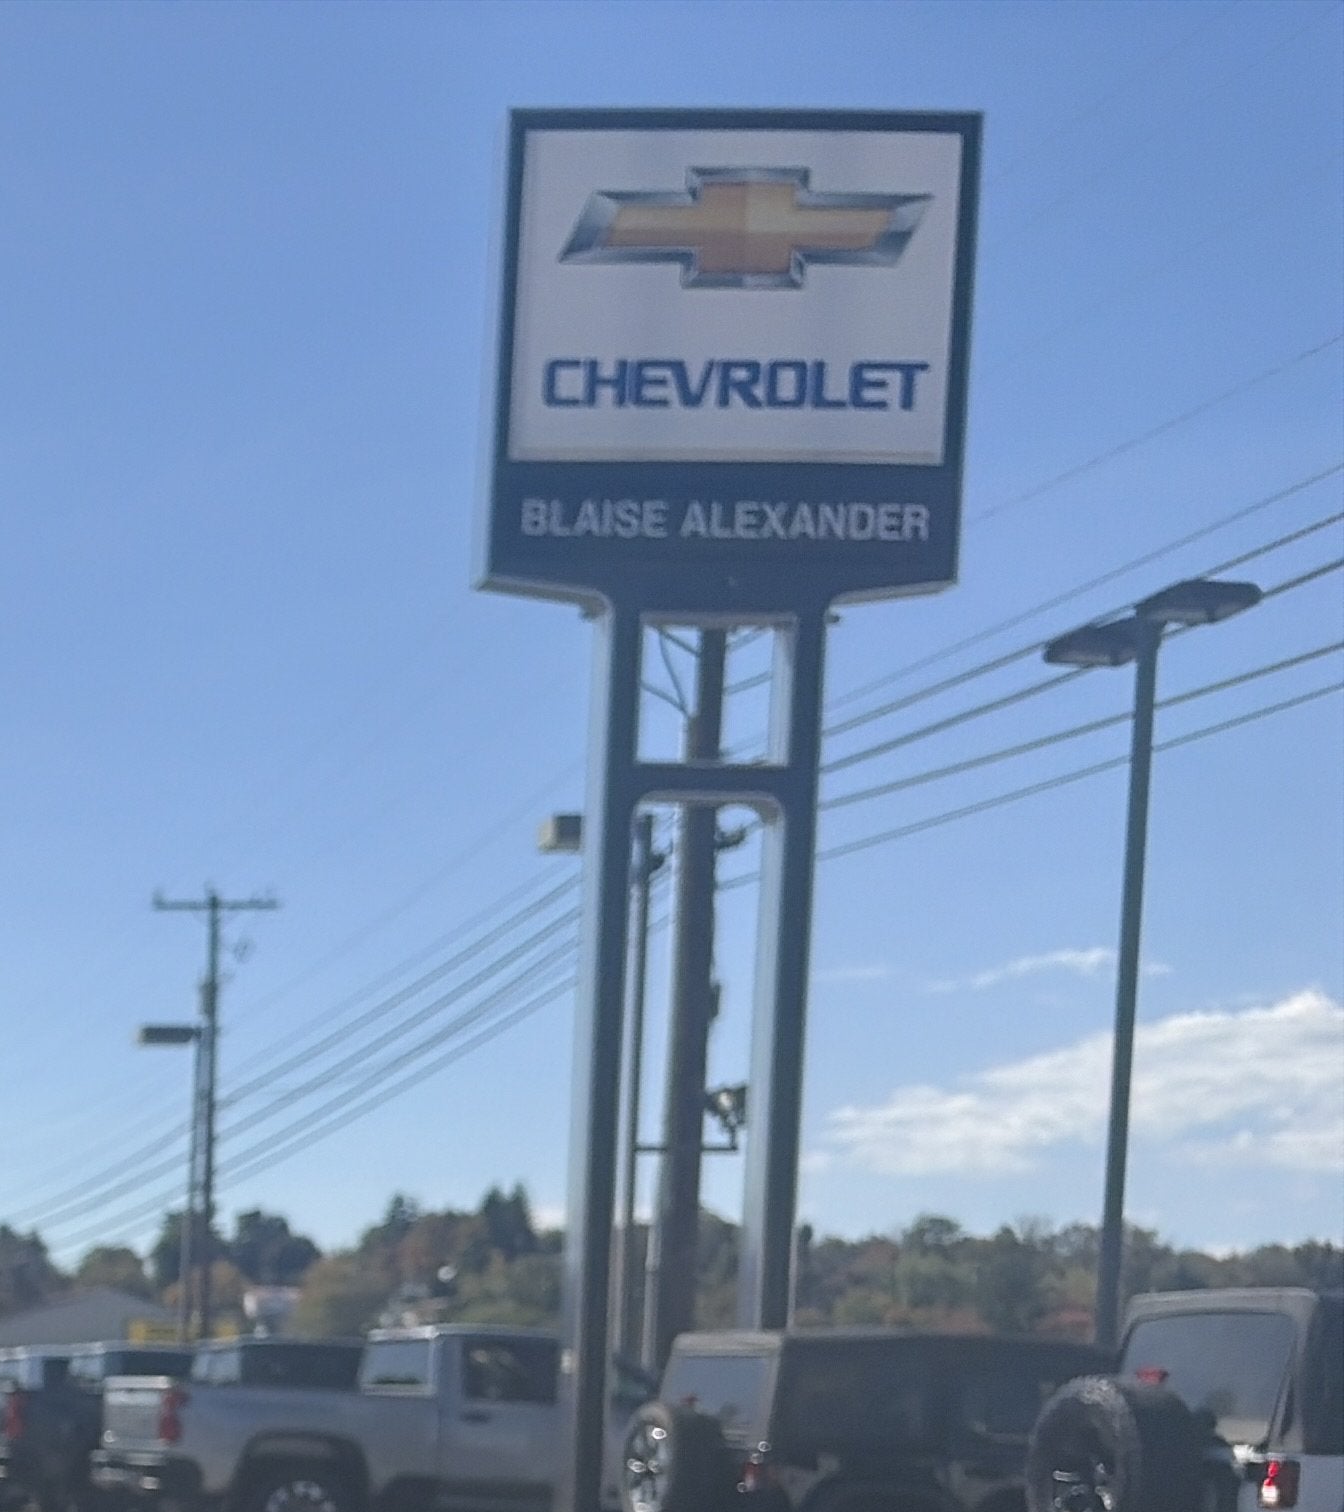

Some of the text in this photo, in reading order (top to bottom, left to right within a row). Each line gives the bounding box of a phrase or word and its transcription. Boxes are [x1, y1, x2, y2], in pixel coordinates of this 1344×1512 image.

[543, 358, 930, 411] CHEVROLET
[521, 498, 930, 542] BLAISE ALEXANDER
